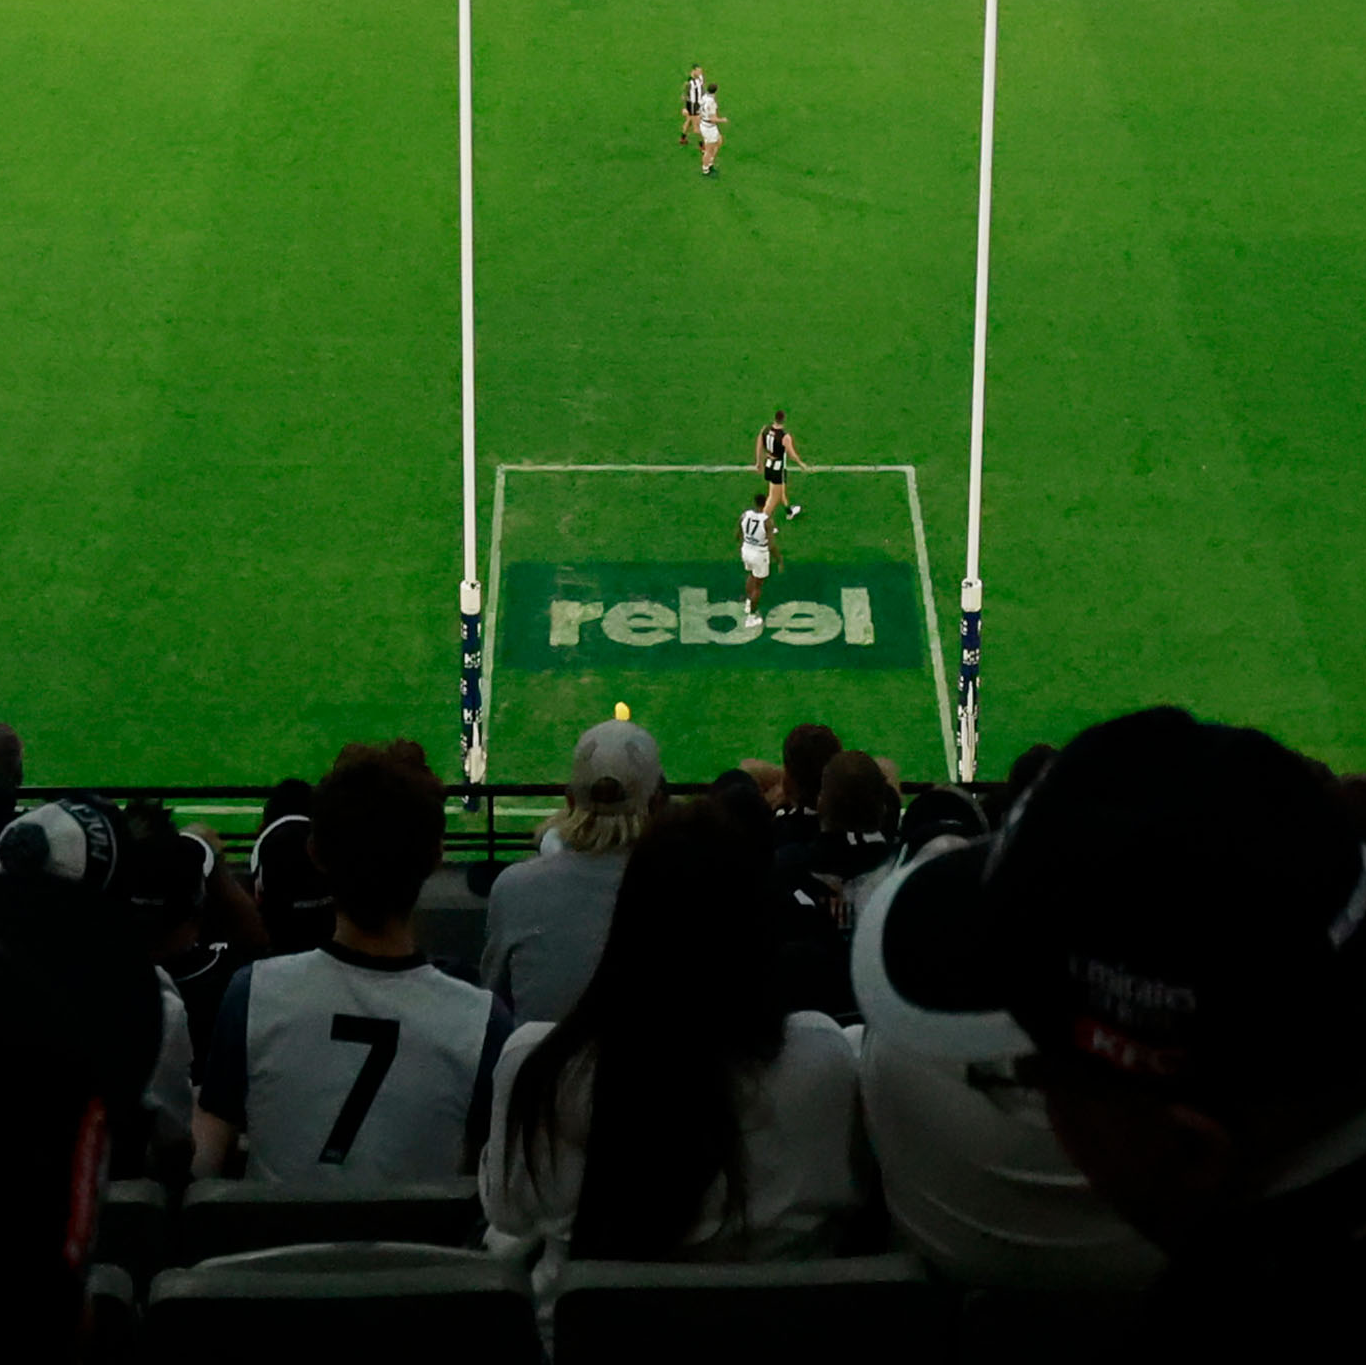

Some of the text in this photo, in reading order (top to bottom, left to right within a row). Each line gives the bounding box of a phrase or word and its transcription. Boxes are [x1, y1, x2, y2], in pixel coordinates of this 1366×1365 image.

[746, 518, 760, 535] 17
[549, 586, 875, 646] rebel
[319, 1012, 401, 1166] 7
